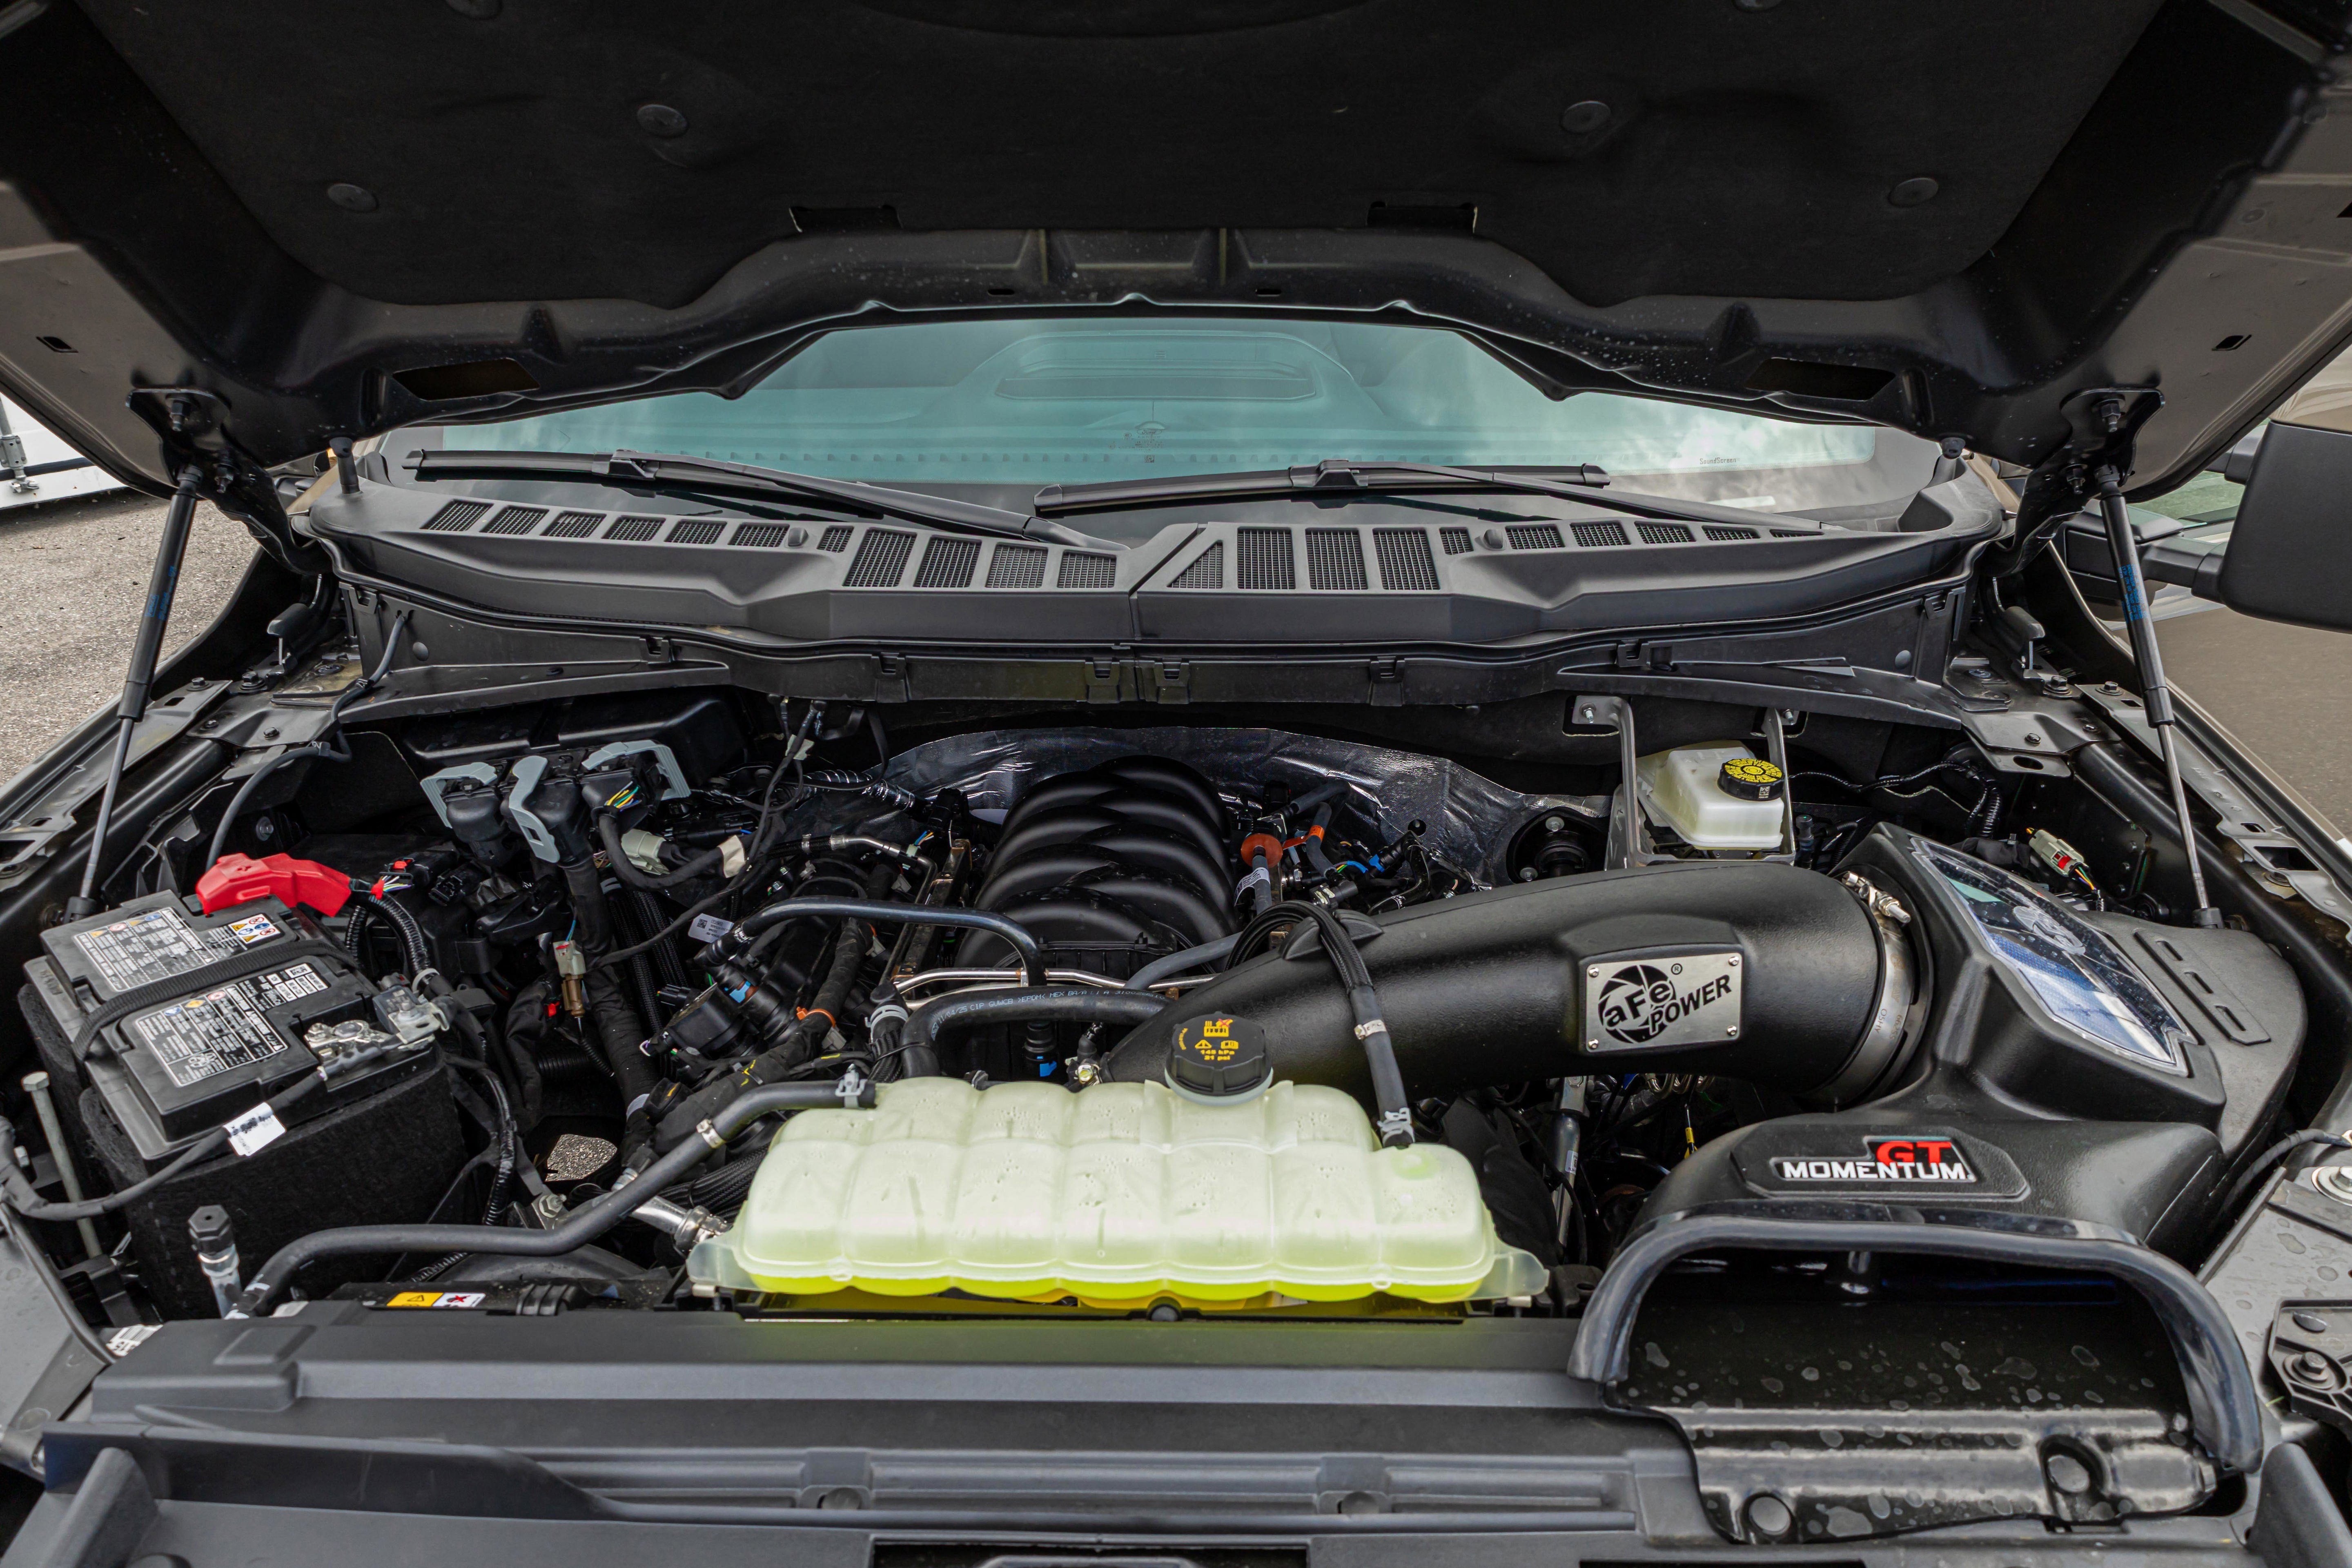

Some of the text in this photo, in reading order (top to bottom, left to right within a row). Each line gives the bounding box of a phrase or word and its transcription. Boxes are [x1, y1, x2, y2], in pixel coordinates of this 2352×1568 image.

[1650, 974, 1732, 1033] POWER
[1876, 1140, 1952, 1167] GT
[1783, 1161, 1967, 1180] MOMENTUM
